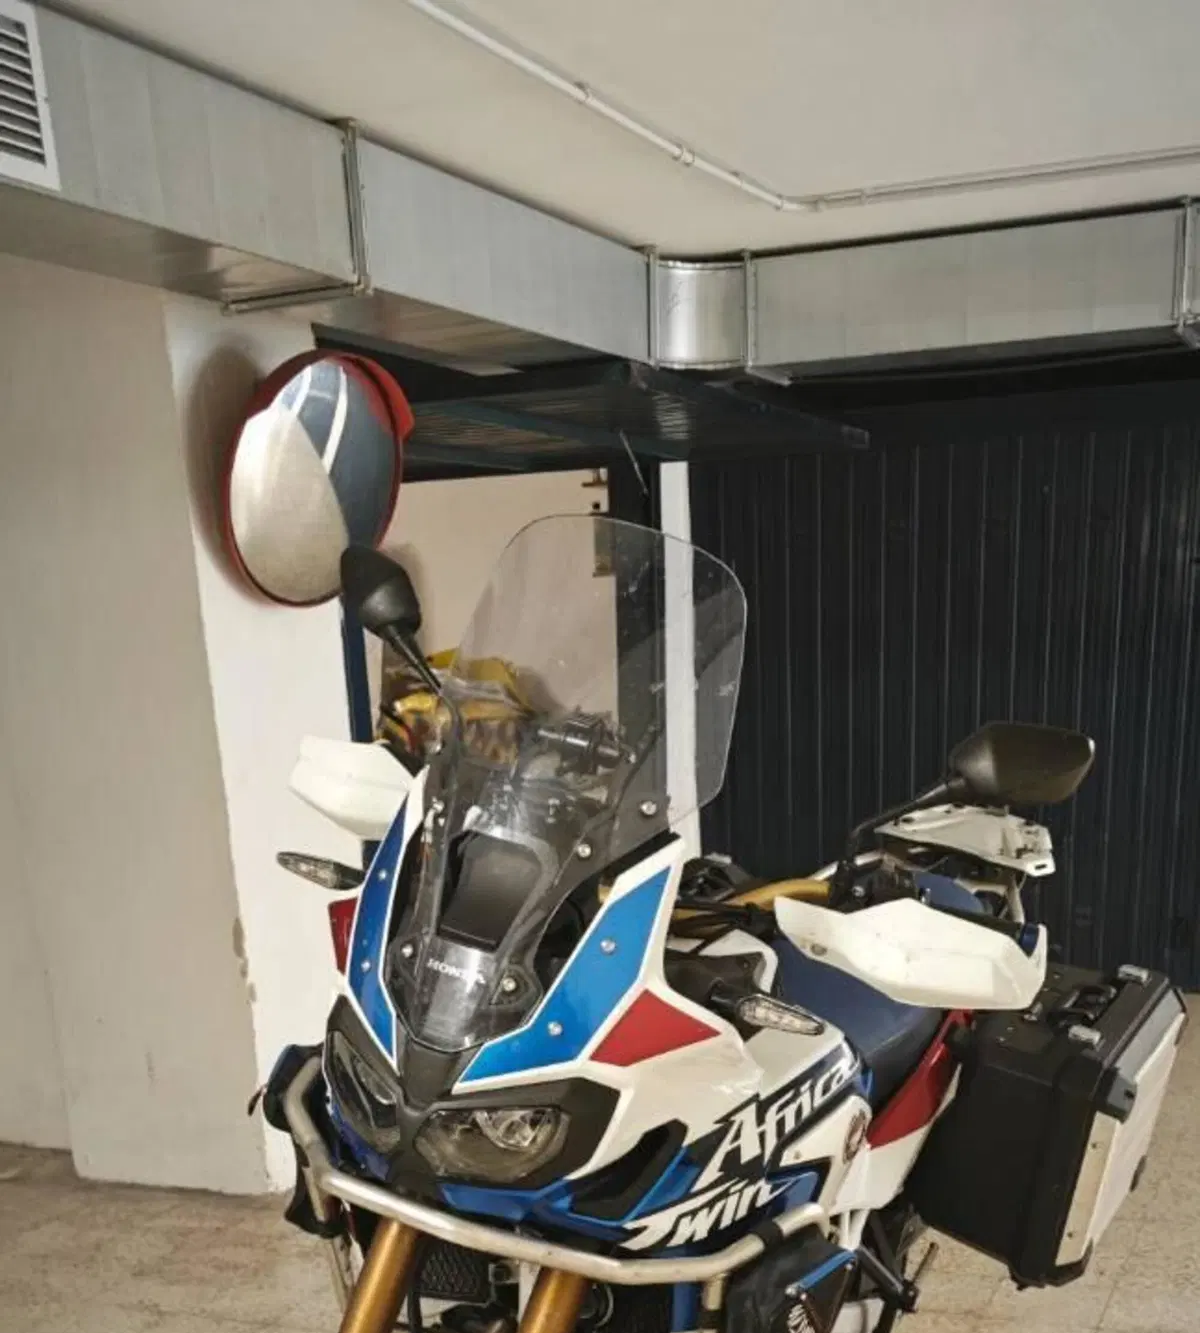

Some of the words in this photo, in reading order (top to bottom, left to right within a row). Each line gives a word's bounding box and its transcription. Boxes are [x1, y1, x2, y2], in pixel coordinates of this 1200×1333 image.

[427, 958, 485, 984] HONA
[690, 1056, 857, 1193] Africa
[619, 1177, 797, 1251] Twin
